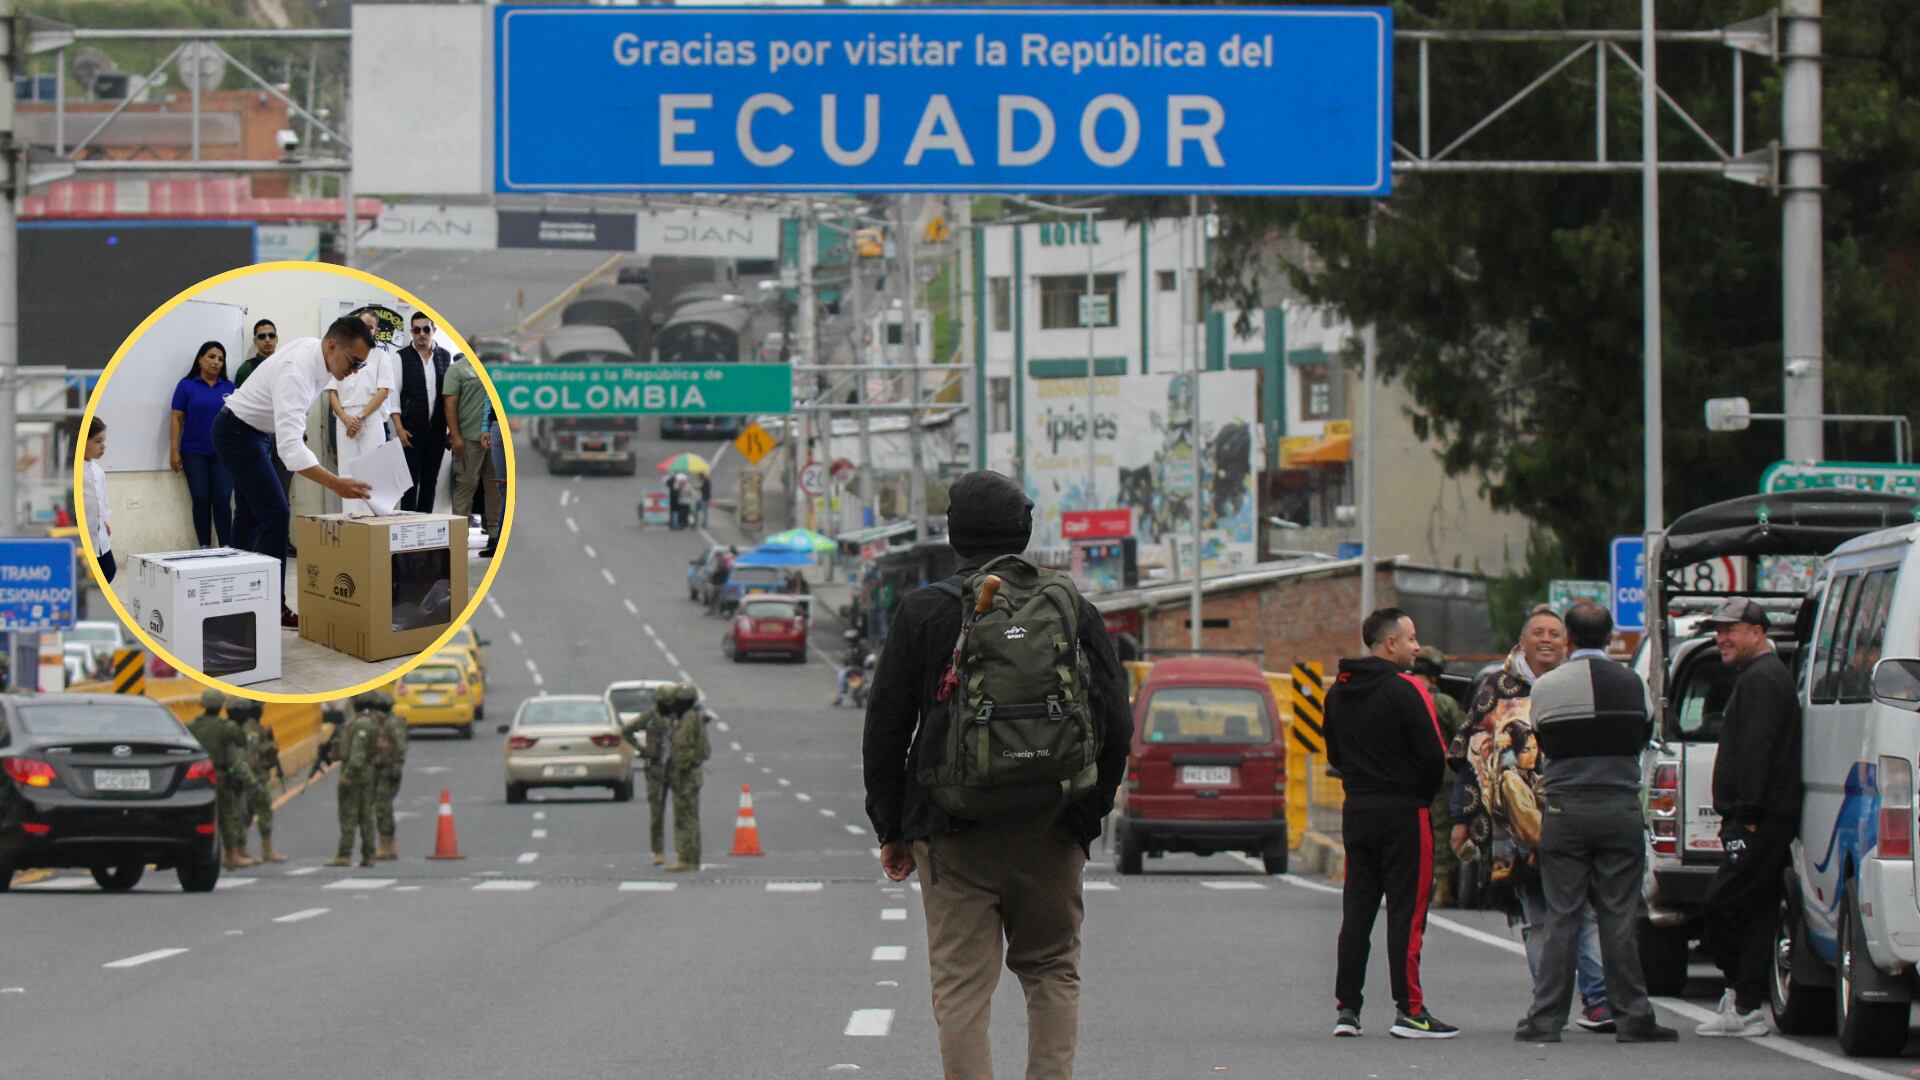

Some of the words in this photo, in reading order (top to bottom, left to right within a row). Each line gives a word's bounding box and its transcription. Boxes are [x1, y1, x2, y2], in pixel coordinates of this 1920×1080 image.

[613, 32, 757, 66] Gracias
[769, 40, 831, 73] por
[844, 33, 963, 66] visitar
[975, 33, 1007, 66] la
[1021, 32, 1206, 74] República
[1218, 34, 1273, 67] del
[659, 92, 1226, 167] ECUADOR
[382, 217, 473, 236] DIAN
[664, 226, 753, 245] DIAN
[1040, 220, 1100, 246] HOTEL
[491, 369, 585, 381] Bienvenidos
[591, 371, 600, 381] a
[604, 369, 619, 381] la
[622, 368, 700, 383] República
[704, 369, 724, 381] de
[508, 385, 706, 410] COLOMBIA
[1, 566, 51, 581] TRAMO
[1002, 750, 1035, 760] Capacity
[1036, 749, 1050, 758] 70L
